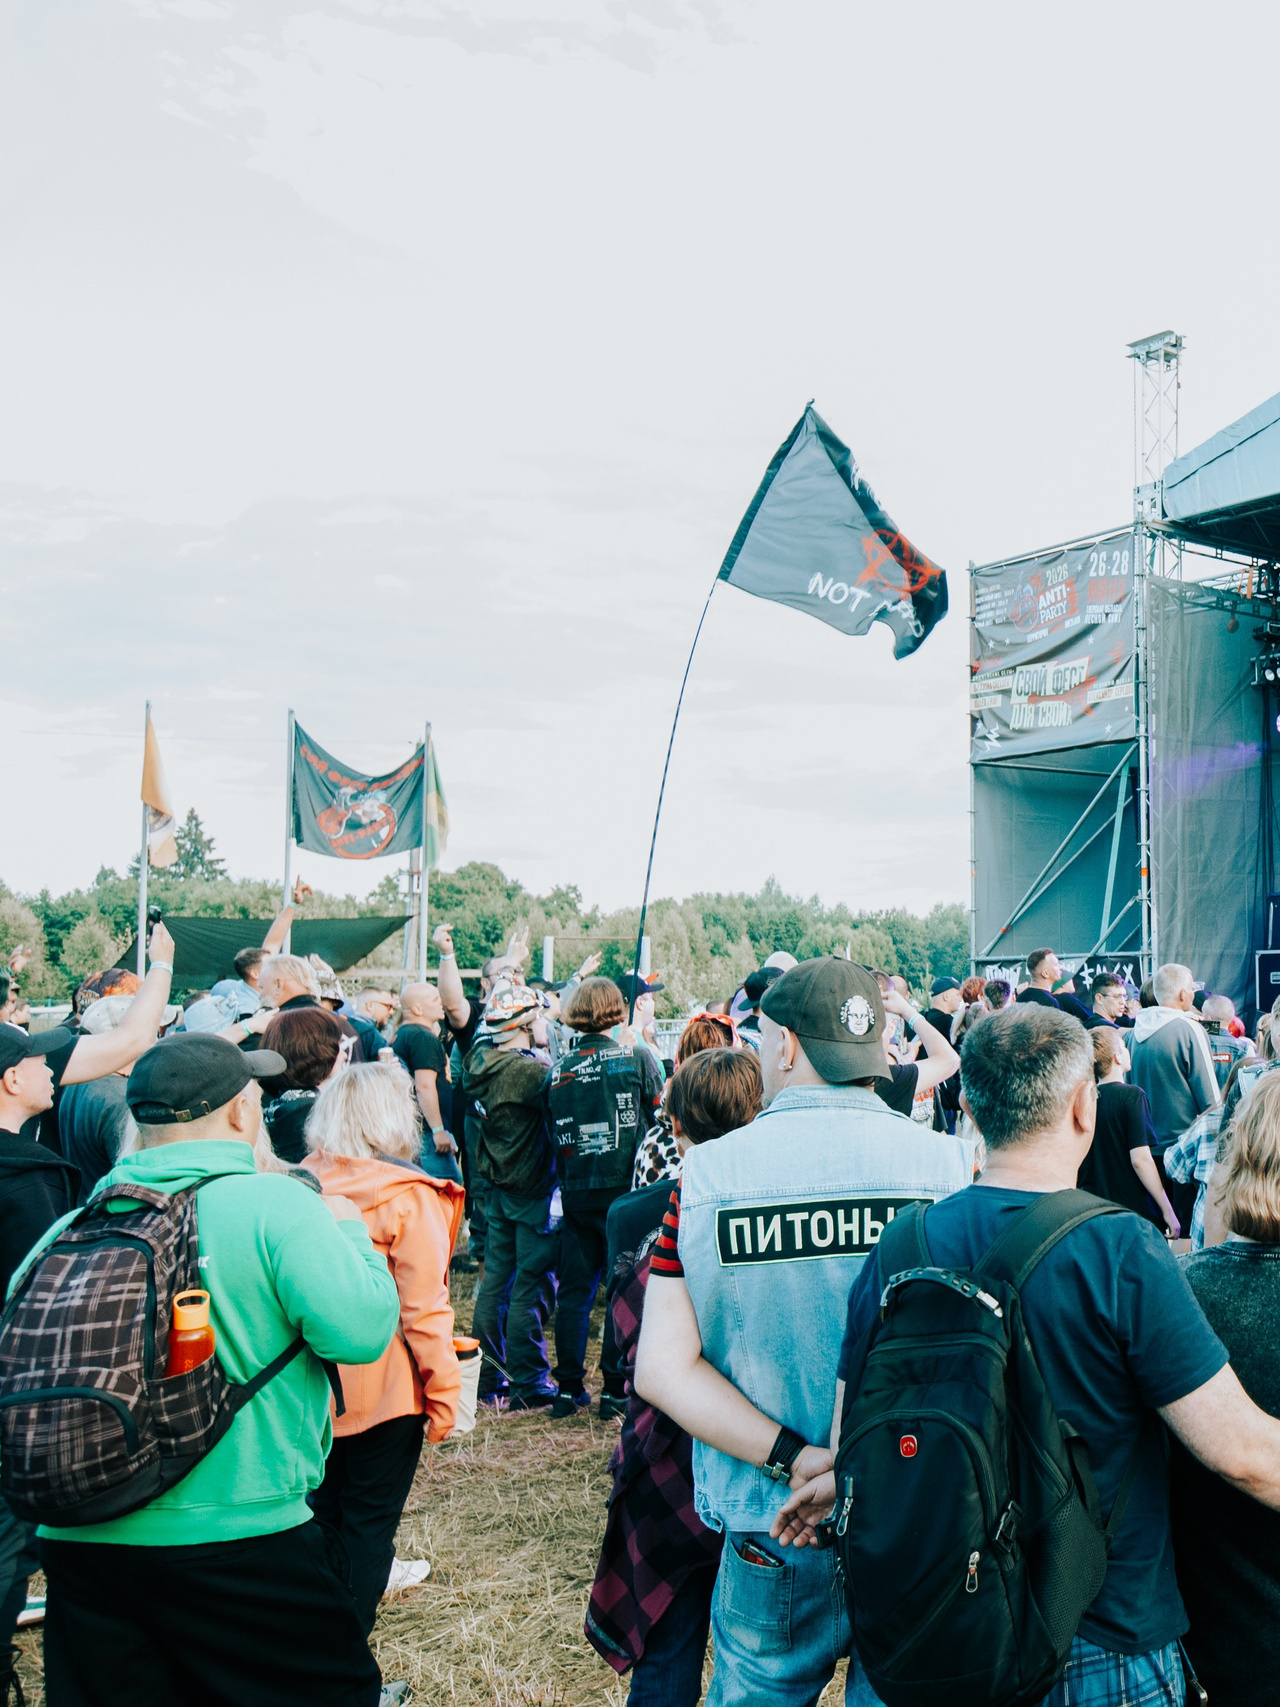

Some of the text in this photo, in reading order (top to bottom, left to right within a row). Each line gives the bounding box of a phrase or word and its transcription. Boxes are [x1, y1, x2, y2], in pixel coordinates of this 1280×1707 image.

[1046, 563, 1069, 587] 2026
[1089, 550, 1130, 578] 26-28
[807, 572, 872, 613] NOT
[1038, 582, 1071, 611] ANTI-
[1039, 601, 1068, 624] PARTY
[1016, 664, 1048, 697] СВОЙ
[1010, 703, 1035, 730] ДЛЯ
